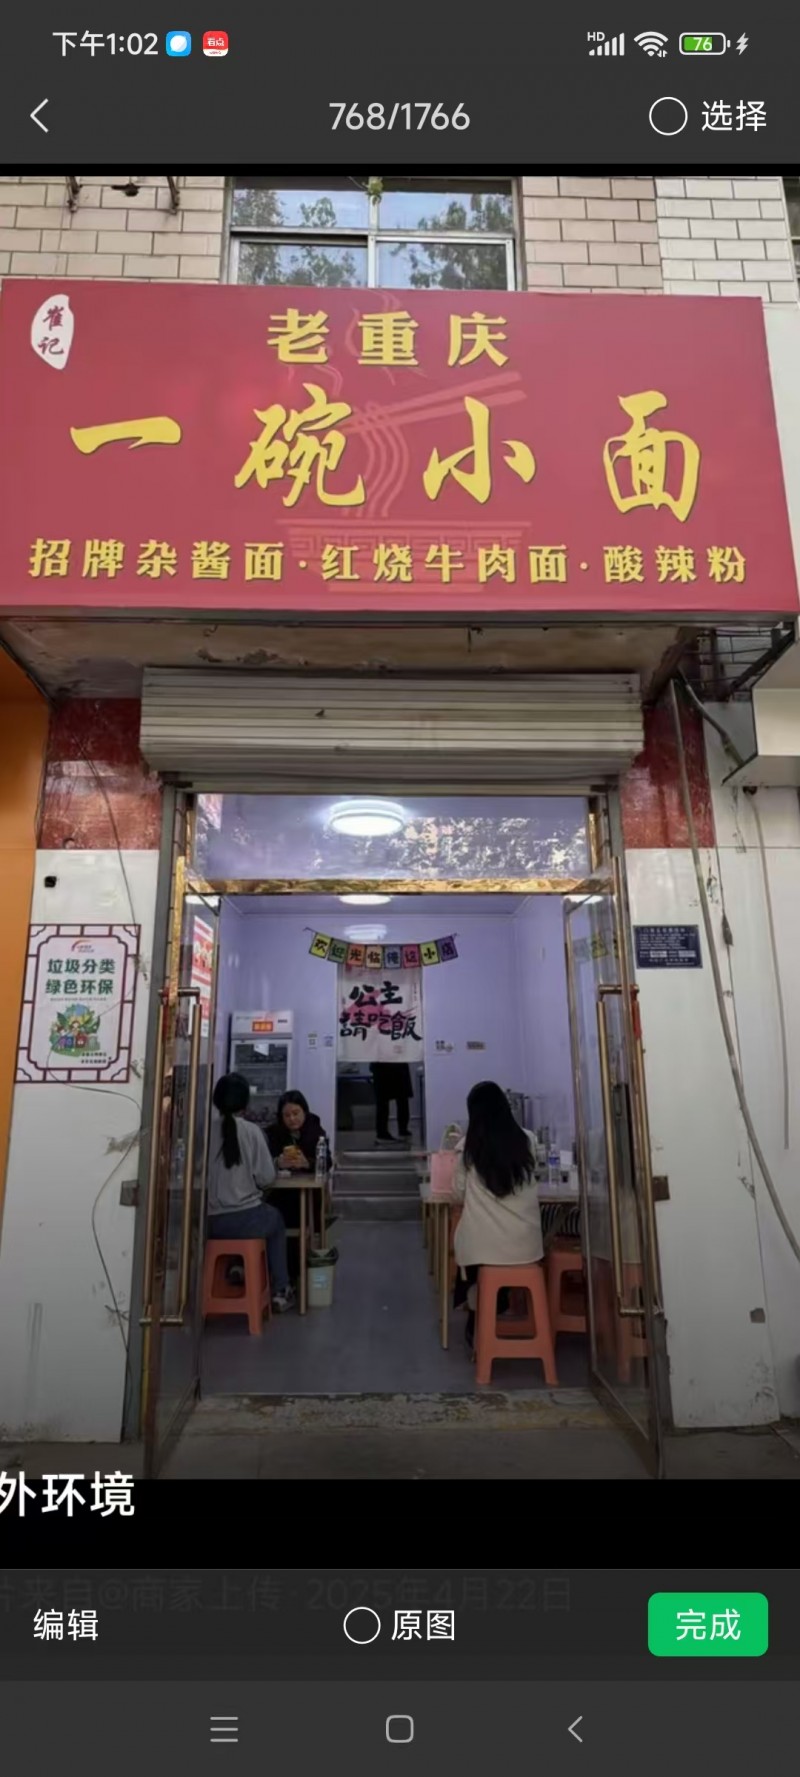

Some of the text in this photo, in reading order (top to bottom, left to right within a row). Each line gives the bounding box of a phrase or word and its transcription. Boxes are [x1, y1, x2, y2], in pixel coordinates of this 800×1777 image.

[52, 30, 159, 57] 下午1:02
[587, 31, 606, 42] HD
[693, 36, 713, 51] 76
[328, 102, 471, 131] 768/1766
[701, 99, 768, 132] 选择
[38, 304, 65, 356] 崔记
[267, 309, 509, 367] 老重庆
[70, 383, 701, 522] 一碗小面
[47, 958, 117, 975] 垃圾分类
[45, 979, 114, 996] 绿色环保
[348, 980, 404, 1008] 公主
[338, 1010, 424, 1042] 請吃飯
[32, 1608, 100, 1642] 编辑
[390, 1608, 457, 1642] 原图
[674, 1608, 742, 1642] 完成
